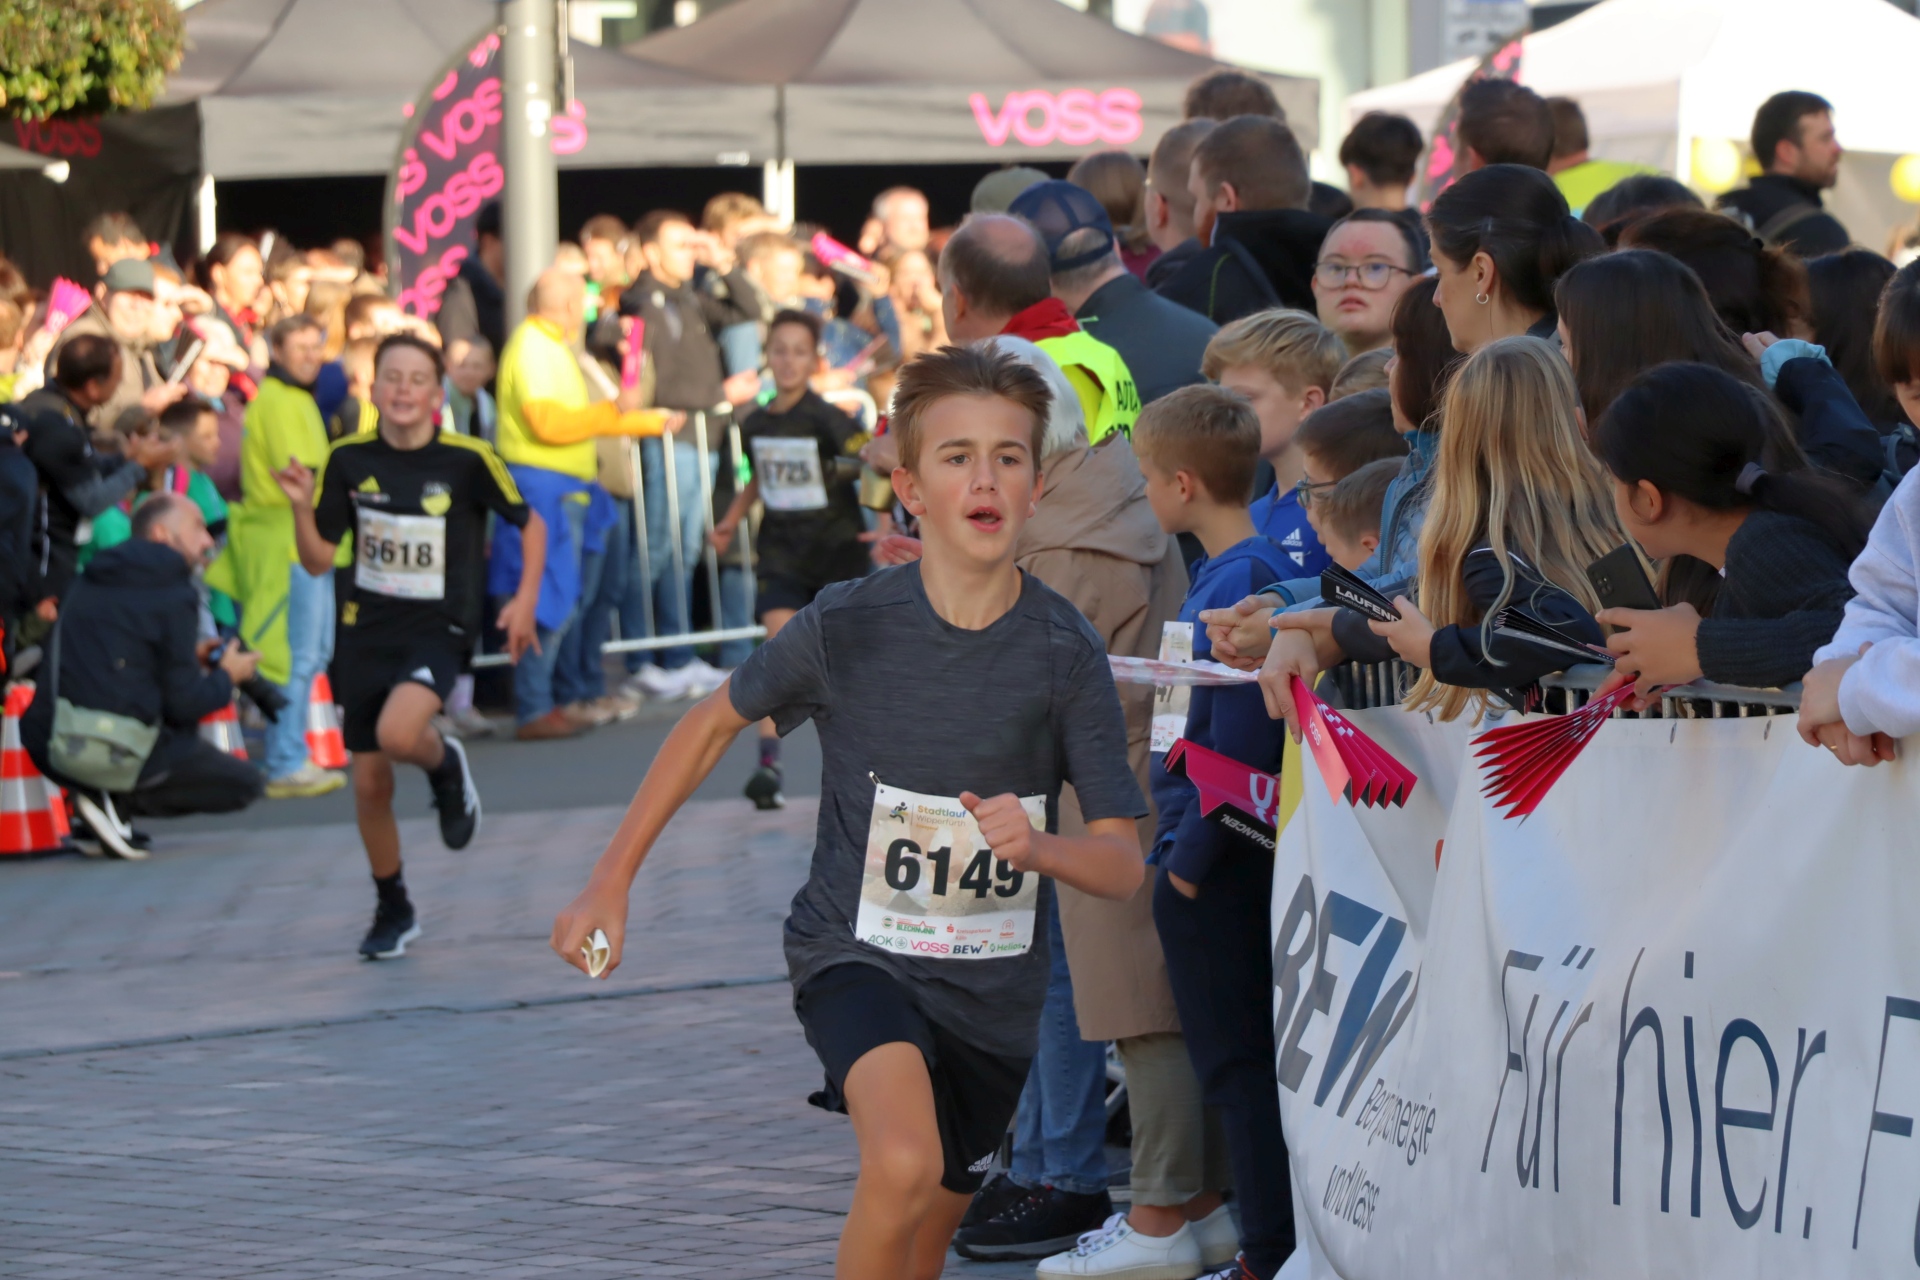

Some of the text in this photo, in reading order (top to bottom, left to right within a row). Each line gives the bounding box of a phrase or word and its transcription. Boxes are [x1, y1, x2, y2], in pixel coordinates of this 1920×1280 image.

[968, 88, 1144, 147] VOSS
[393, 151, 505, 256] VOSS
[364, 534, 433, 568] 5618
[916, 814, 967, 828] Wipperfürth
[917, 804, 967, 818] Stadtlauf
[1220, 813, 1276, 850] CHANCEN.
[884, 838, 1024, 899] 6149
[867, 934, 1021, 954] AOK VOSS BEW Helios
[1480, 944, 1595, 1194] Für
[1613, 946, 1827, 1240] hier.
